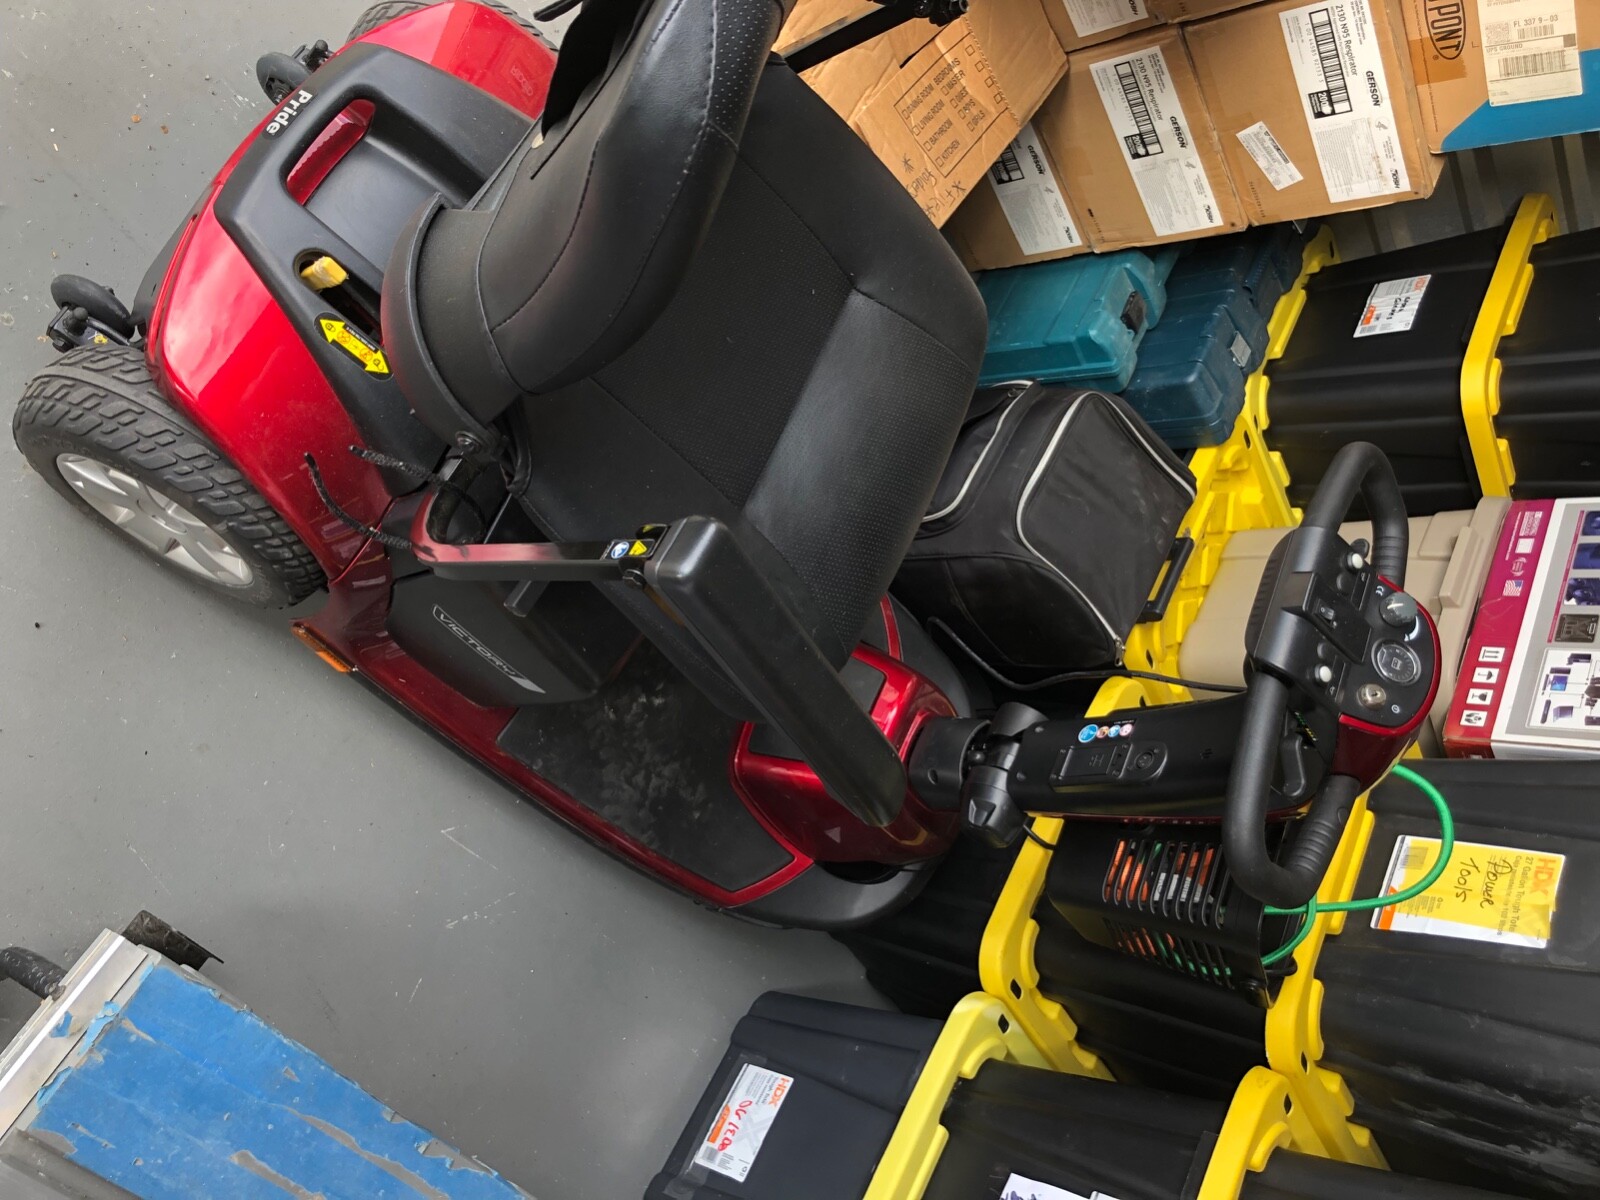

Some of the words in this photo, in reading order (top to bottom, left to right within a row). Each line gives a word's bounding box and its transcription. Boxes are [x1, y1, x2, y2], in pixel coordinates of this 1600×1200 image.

[1336, 4, 1346, 22] 2130
[1428, 0, 1462, 51] PONT
[1513, 20, 1521, 28] FL
[1524, 17, 1536, 26] 337
[1340, 23, 1351, 37] N95
[1344, 39, 1358, 76] Respirator
[1500, 43, 1523, 51] GROUND
[933, 58, 961, 86] BEDROOMS
[947, 70, 965, 91] MASTER
[920, 83, 934, 102] ROOM
[1136, 58, 1146, 74] 2130
[1142, 73, 1152, 88] N95
[1148, 88, 1163, 120] Respirator
[1366, 70, 1380, 106] GERSON
[266, 89, 313, 134] Pride
[919, 112, 933, 130] LIVING
[931, 99, 945, 117] ROOM
[930, 118, 953, 145] BATHROOM
[1169, 116, 1187, 148] GERSON
[941, 140, 960, 161] KITCHEN
[1027, 144, 1045, 175] GERSON
[440, 613, 516, 675] VICTORY
[1526, 856, 1534, 865] 27
[1518, 865, 1531, 888] Gallon
[1531, 858, 1556, 896] HDX
[1512, 890, 1525, 913] Tough
[1509, 915, 1519, 932] Tote
[768, 1078, 790, 1107] HDX
